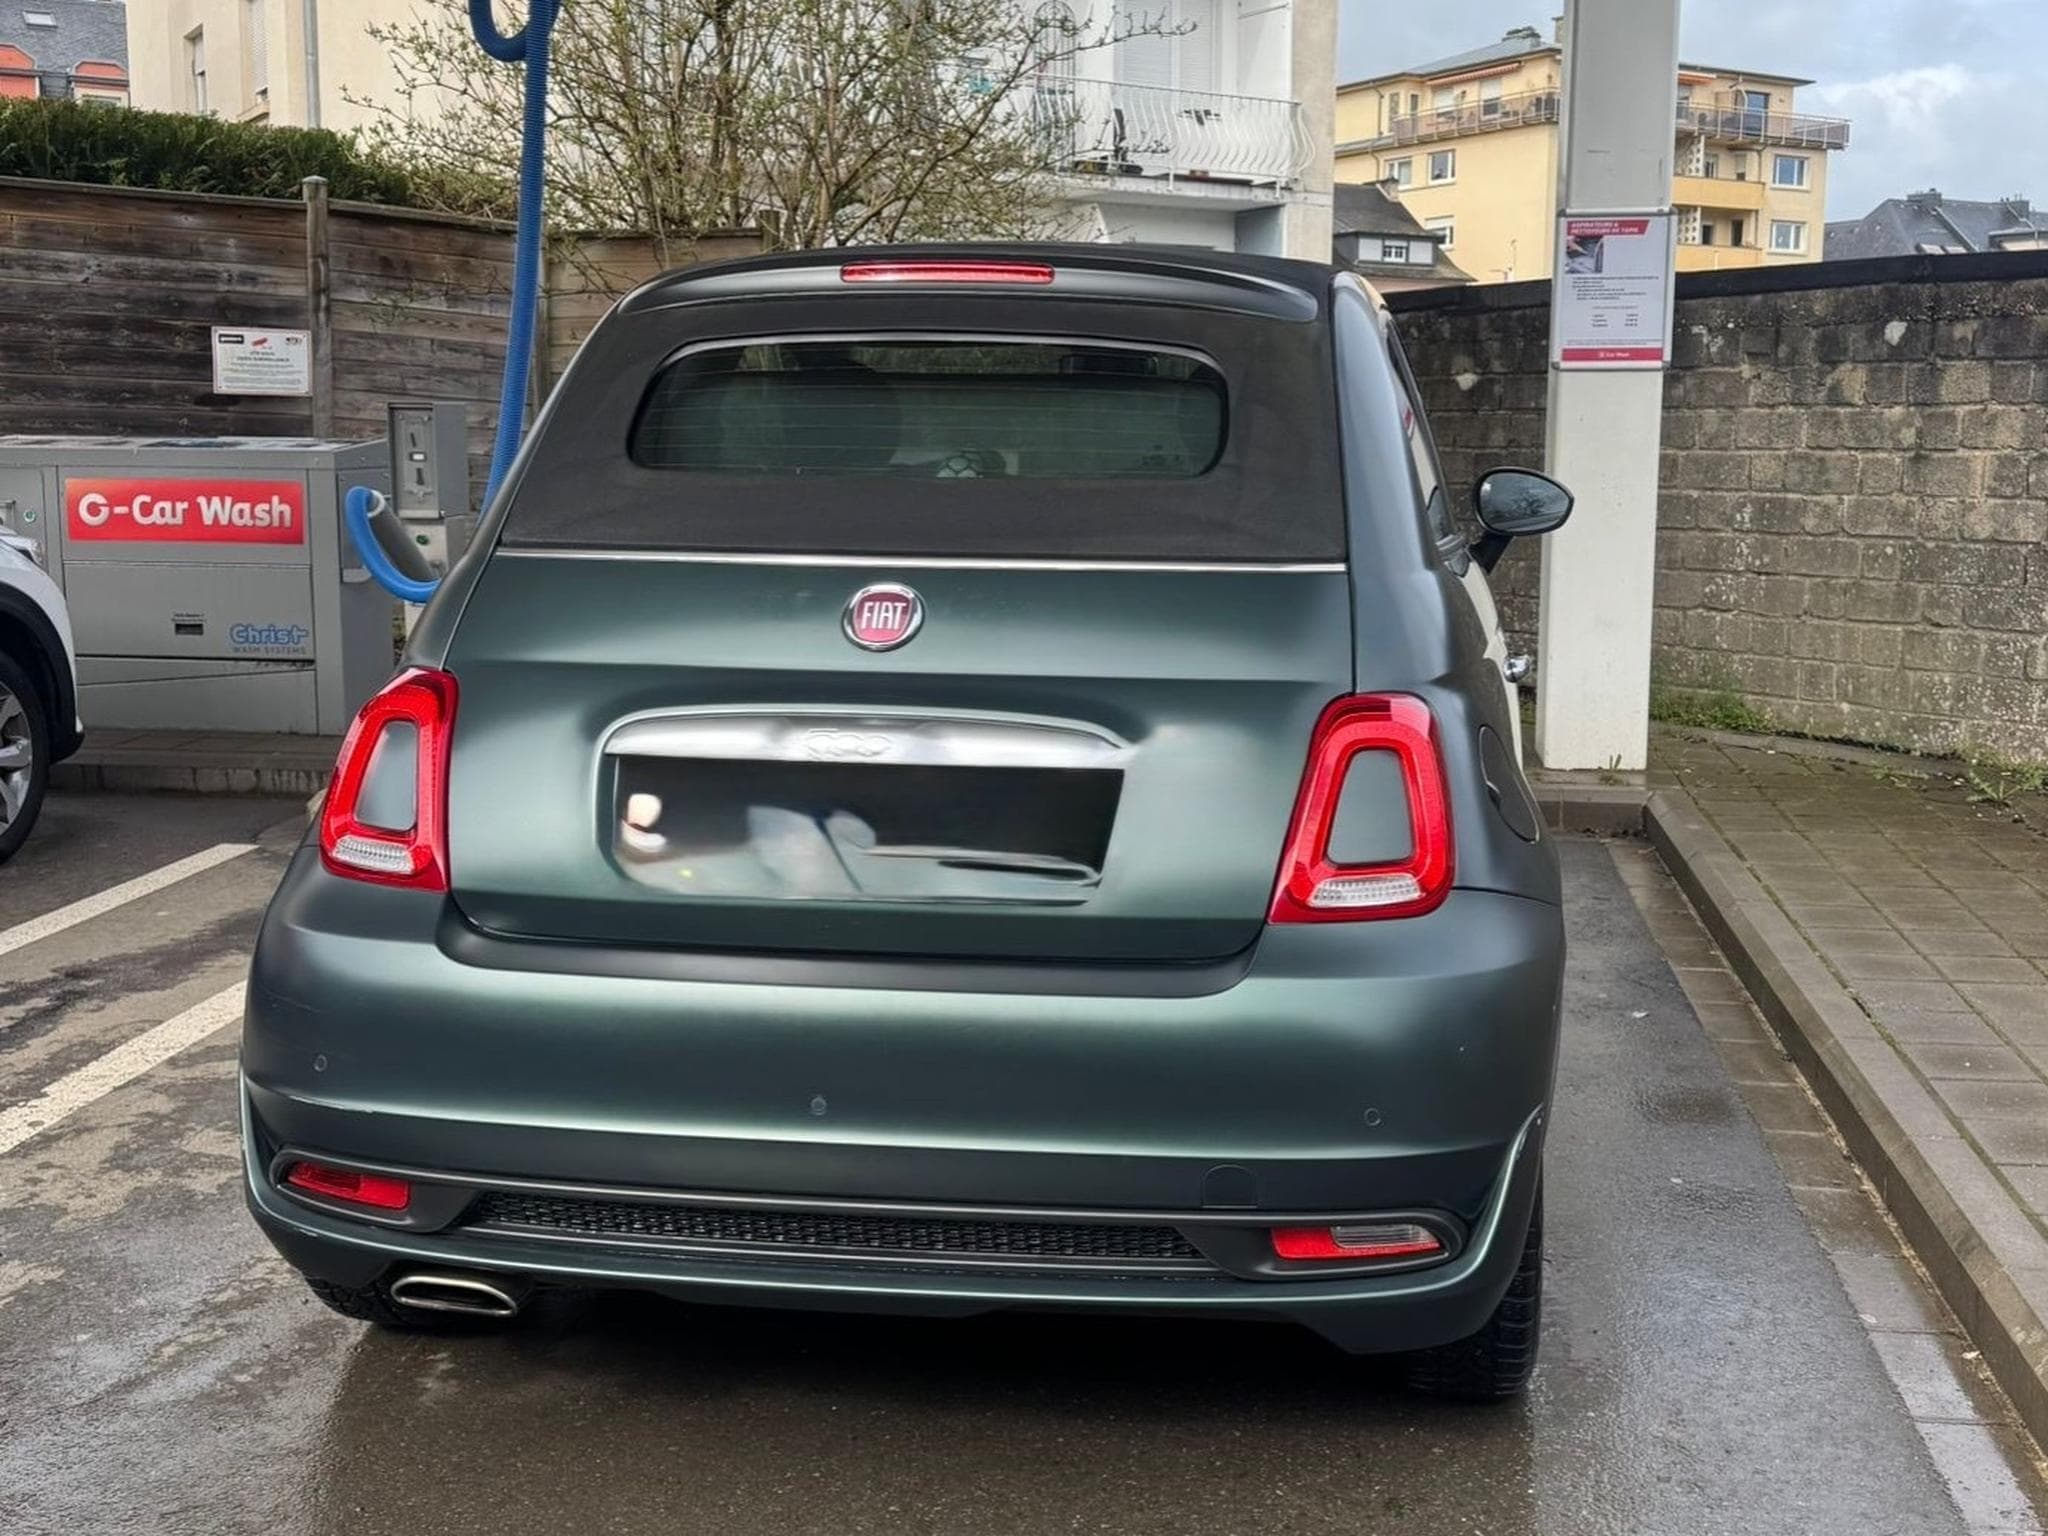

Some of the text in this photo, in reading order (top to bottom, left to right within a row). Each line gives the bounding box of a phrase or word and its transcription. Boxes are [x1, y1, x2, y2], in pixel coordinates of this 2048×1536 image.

[196, 495, 292, 527] Wash
[861, 601, 907, 629] FIAT
[229, 622, 309, 645] Christ
[233, 646, 307, 655] WASH SYSTEMS
